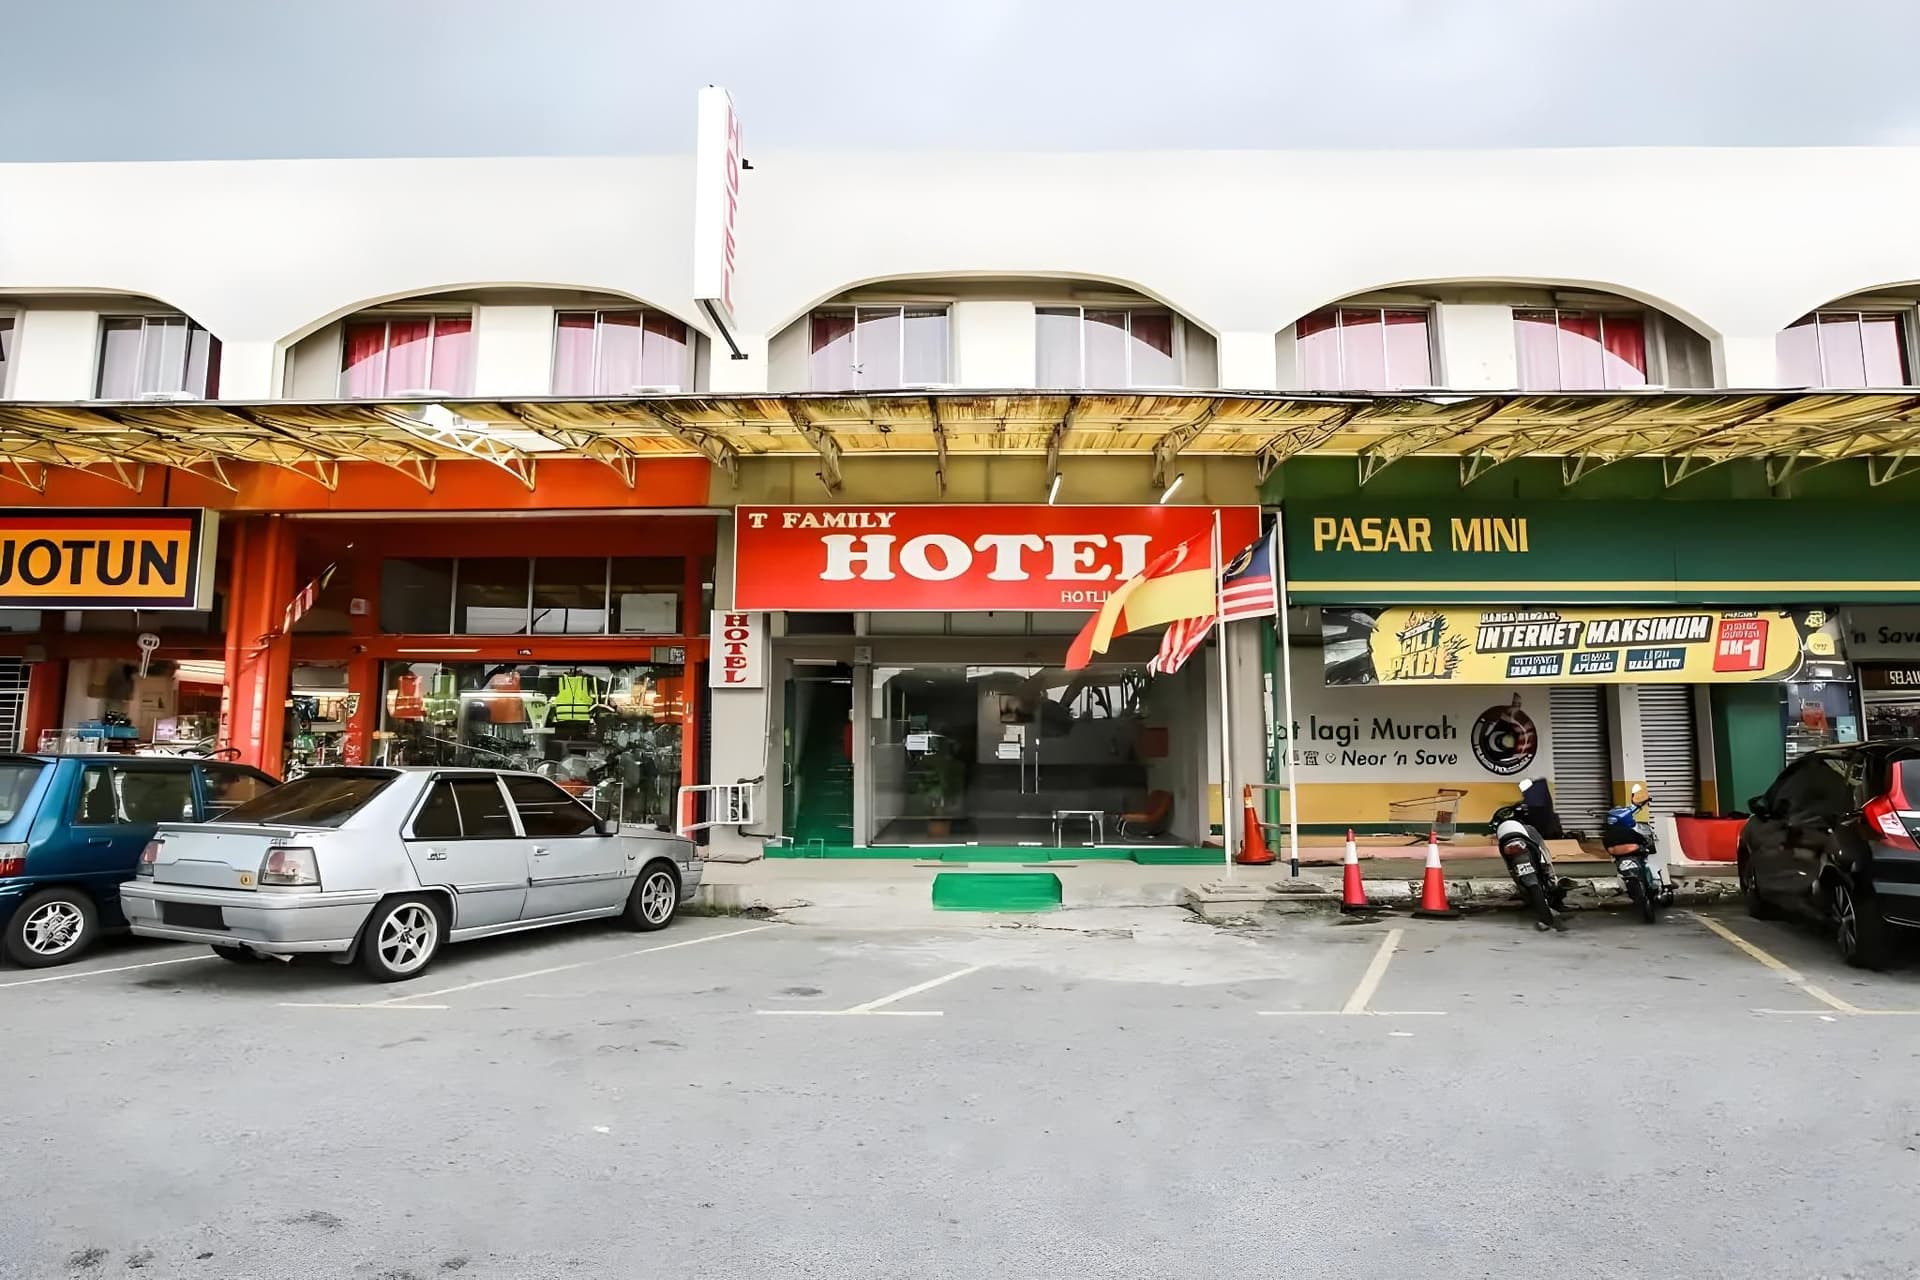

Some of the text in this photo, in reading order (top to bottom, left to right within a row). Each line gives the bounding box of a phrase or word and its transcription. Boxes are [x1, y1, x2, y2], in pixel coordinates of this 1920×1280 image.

[725, 104, 738, 314] HOTEL
[748, 511, 896, 529] T FAMILY
[1313, 517, 1529, 552] PASAR MINI
[723, 614, 750, 684] HOTEL
[1476, 616, 1709, 650] INTERNET MAKSIMUM
[1310, 715, 1359, 748] lagi
[1371, 714, 1457, 741] Murah
[1339, 744, 1387, 766] Near
[1414, 749, 1457, 766] Save
